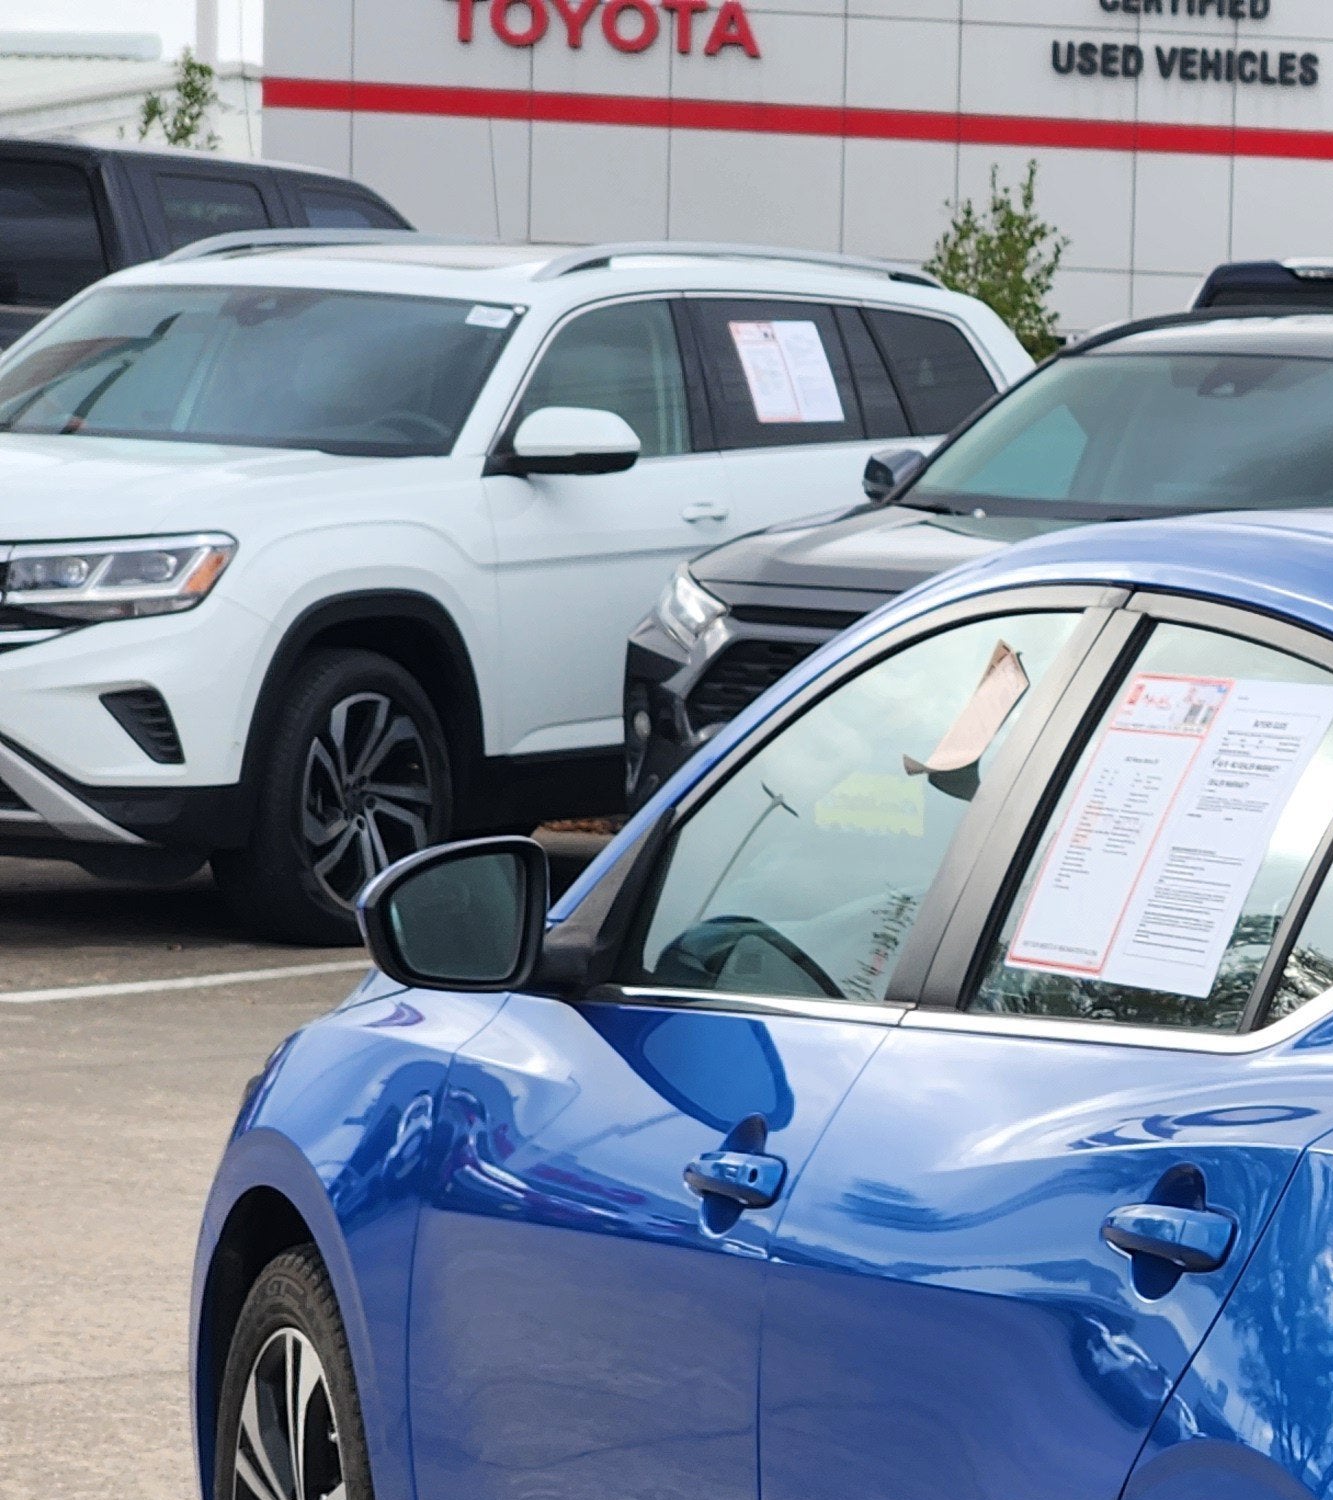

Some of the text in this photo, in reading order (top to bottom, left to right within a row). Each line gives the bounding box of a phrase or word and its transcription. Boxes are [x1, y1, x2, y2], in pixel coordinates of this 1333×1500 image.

[457, 0, 761, 58] TOYOTA
[1052, 40, 1320, 86] USED VEHICLES
